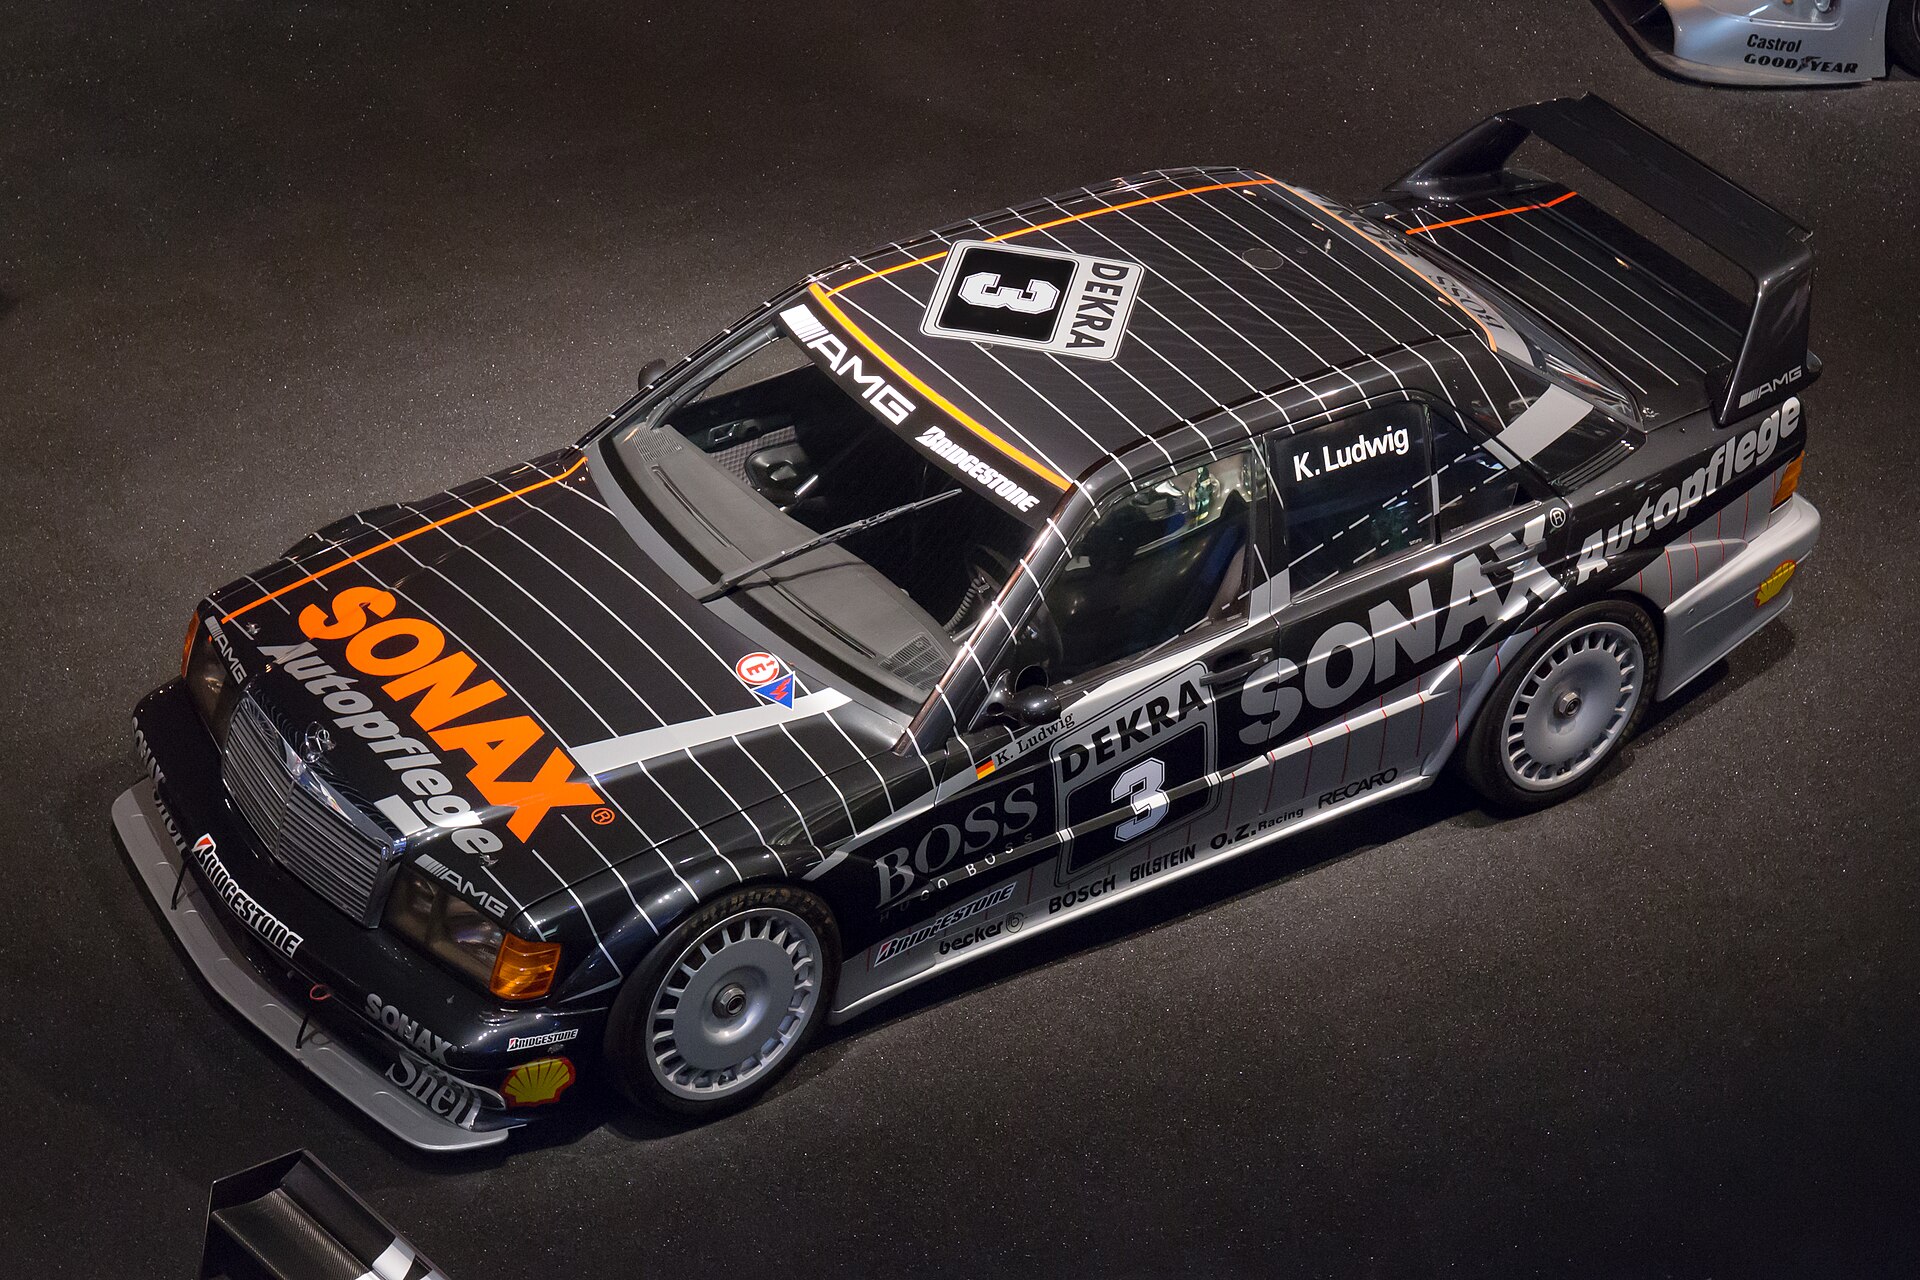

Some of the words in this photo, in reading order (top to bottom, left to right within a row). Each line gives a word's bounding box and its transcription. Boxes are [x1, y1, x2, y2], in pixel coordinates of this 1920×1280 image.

[1747, 34, 1802, 53] Castrol
[958, 272, 1061, 314] 3
[1065, 262, 1130, 349] DEKRA
[807, 333, 917, 426] AMG
[1758, 365, 1802, 399] AMG
[914, 425, 1041, 513] BRIDGESTONE
[1293, 451, 1321, 482] K.
[1322, 425, 1410, 472] Ludwig
[1576, 396, 1801, 586] Autopflege
[216, 638, 248, 685] AMG
[1238, 514, 1568, 745] SONAX
[256, 641, 504, 854] Autopflege
[298, 586, 606, 844] SONAX
[995, 750, 1014, 768] K.
[1015, 712, 1076, 753] Ludwig
[1059, 679, 1208, 783] DEKRA
[1111, 757, 1170, 843] 3
[1317, 767, 1398, 810] RECARO
[872, 782, 1039, 910] BOSS
[1048, 875, 1116, 914] BOSCH
[1129, 844, 1197, 883] BILSTEIN
[1257, 808, 1304, 831] Racing
[191, 833, 304, 958] BRIDGESTONE
[441, 872, 509, 919] AMG
[874, 881, 1017, 968] BRIDGESTONE
[938, 920, 1004, 956] becker
[364, 992, 454, 1066] SONAX
[507, 1028, 579, 1052] BRIDGESTONE
